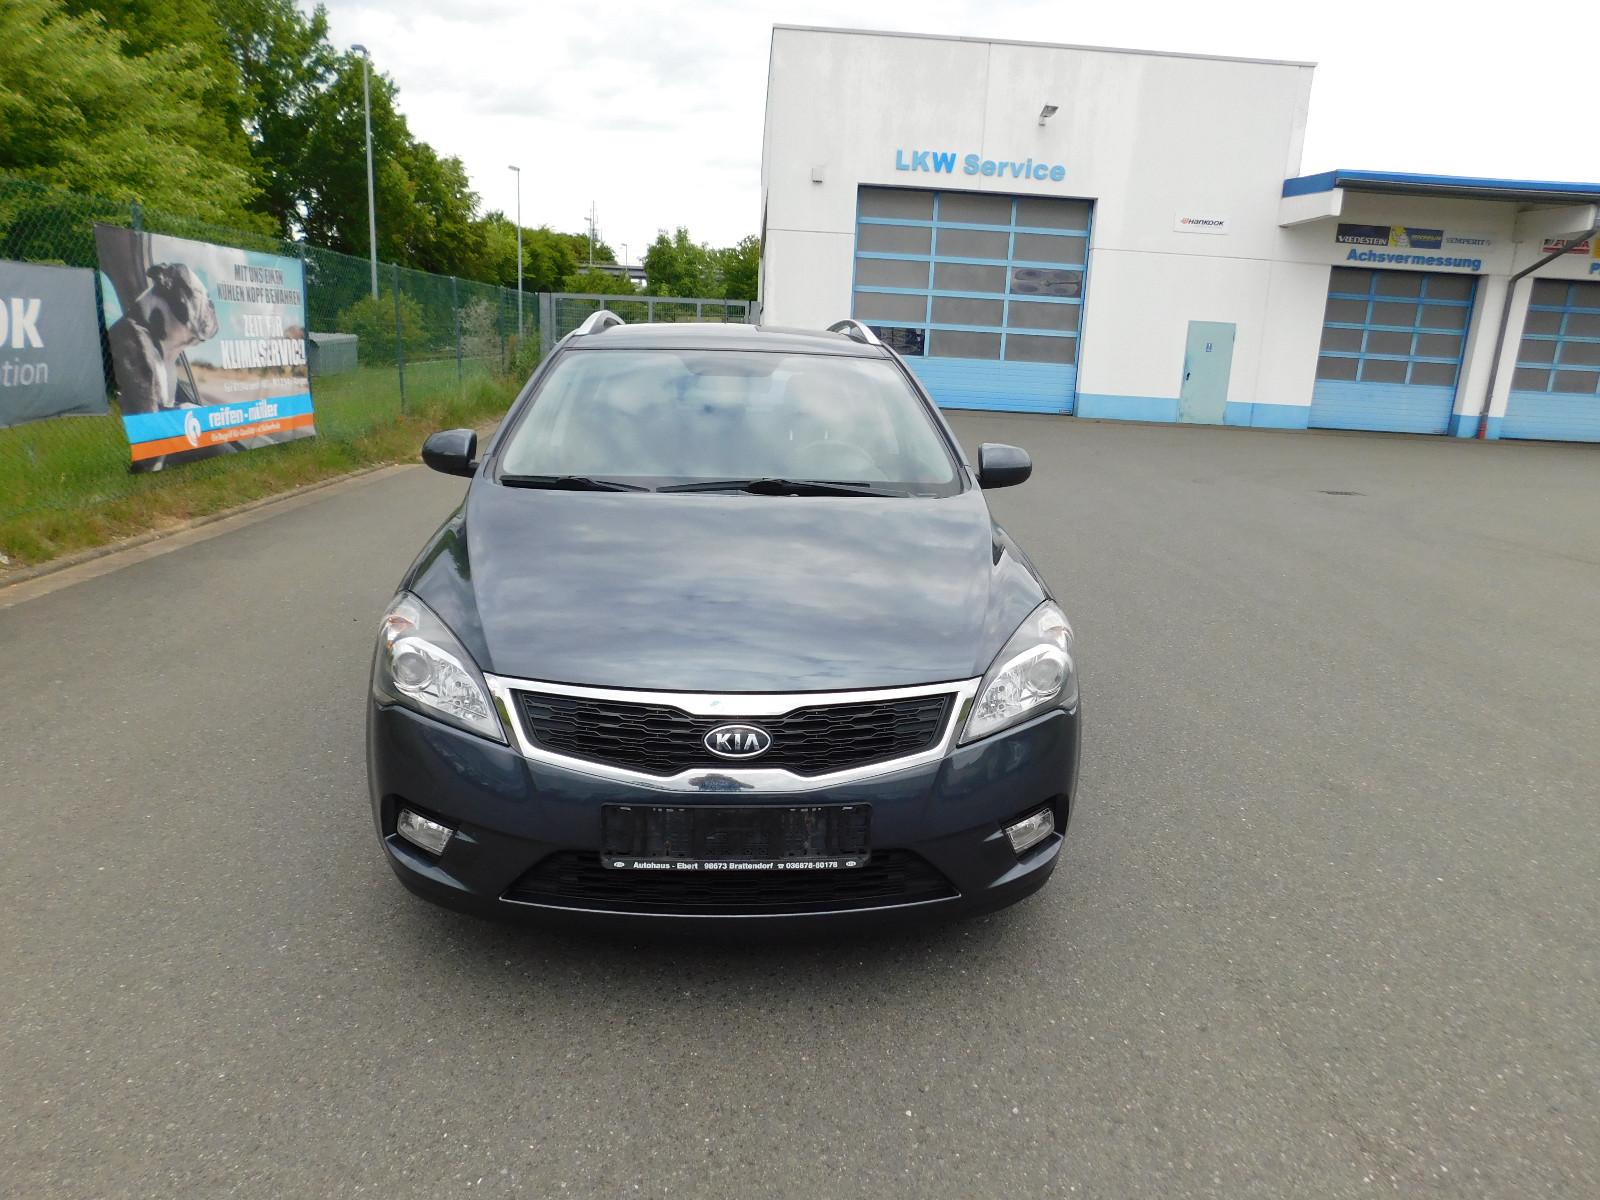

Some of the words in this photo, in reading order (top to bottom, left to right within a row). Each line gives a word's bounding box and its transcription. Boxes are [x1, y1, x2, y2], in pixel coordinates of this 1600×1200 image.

[896, 149, 957, 174] LKW
[963, 153, 1066, 182] Service
[1337, 235, 1388, 245] VREDESTEIN
[1346, 249, 1482, 271] Achsvermessung
[234, 263, 248, 282] MIT
[246, 286, 264, 304] KOPF
[715, 732, 761, 751] KIA
[633, 861, 670, 869] Autohaus
[677, 862, 698, 870] Ebert
[729, 862, 773, 870] Brattendorf
